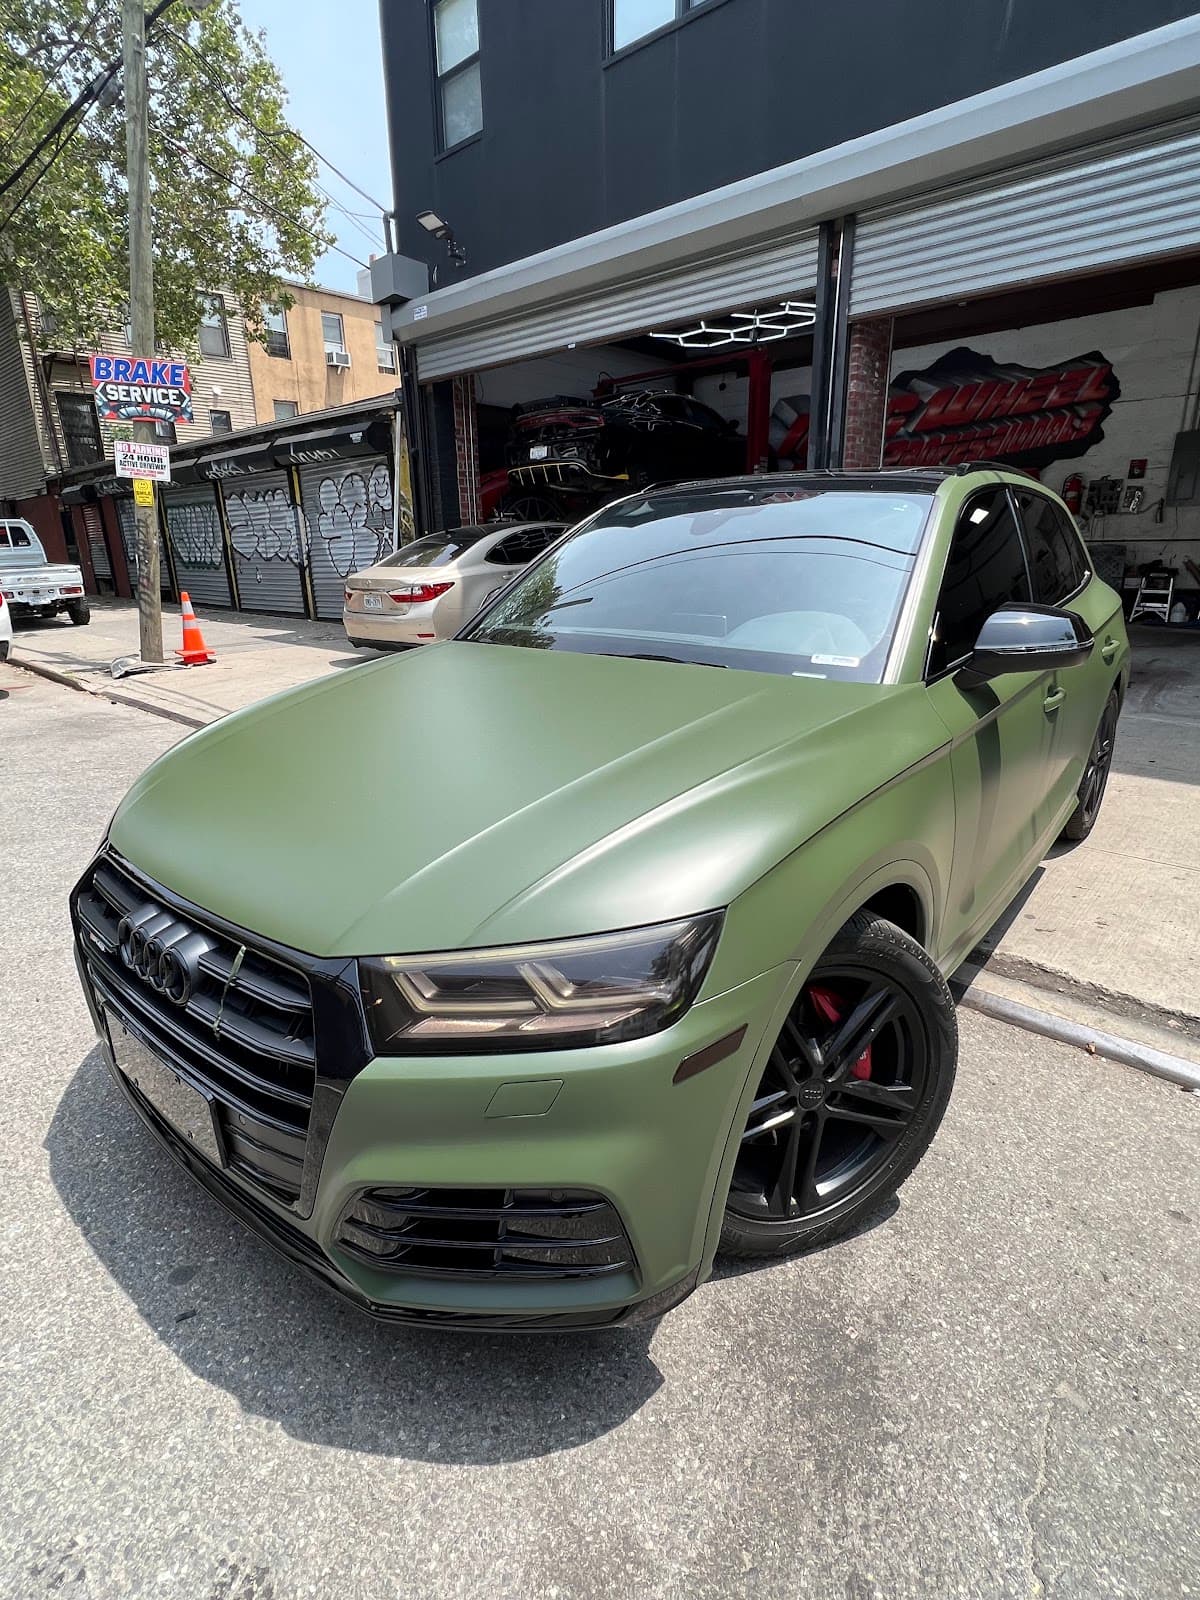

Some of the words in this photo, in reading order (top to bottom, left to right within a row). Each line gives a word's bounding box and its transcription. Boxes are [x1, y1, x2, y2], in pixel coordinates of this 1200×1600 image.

[94, 357, 186, 387] BRAKE
[105, 384, 181, 406] SERVICE
[116, 443, 129, 452] NO
[130, 444, 167, 457] PARKING
[119, 459, 138, 468] ACTIVE
[139, 461, 167, 470] DRIVEWAY
[137, 454, 163, 463] HOUR
